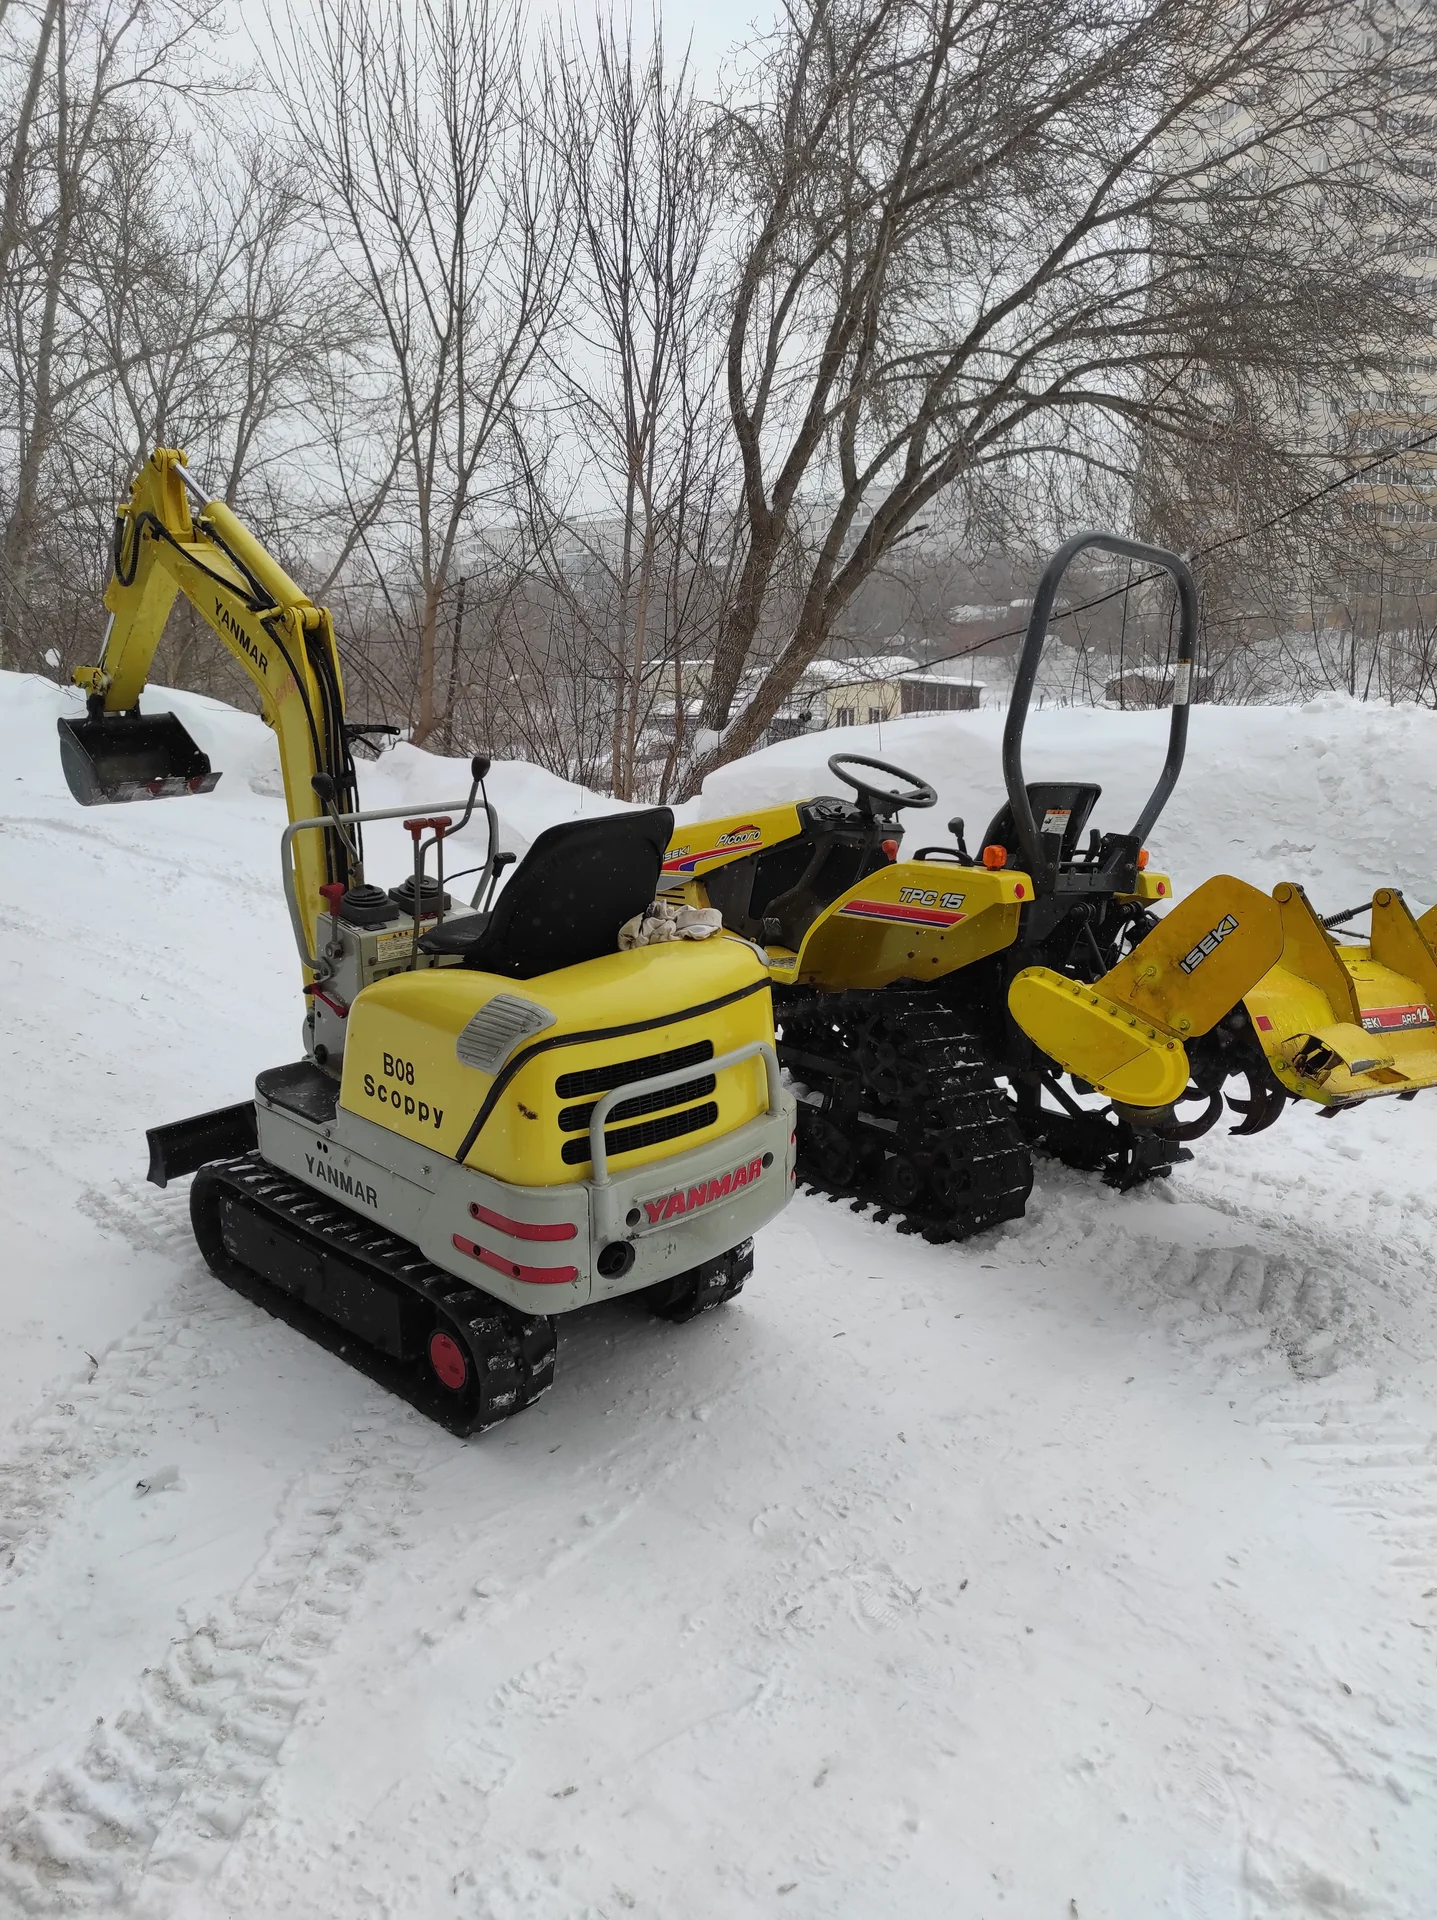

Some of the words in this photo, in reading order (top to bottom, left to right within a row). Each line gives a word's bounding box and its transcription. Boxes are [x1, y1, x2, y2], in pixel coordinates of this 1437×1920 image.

[214, 597, 268, 675] YANMAR
[900, 887, 937, 905] TPC
[940, 893, 966, 909] 15
[1179, 914, 1239, 974] ISEKI
[1361, 1017, 1381, 1029] SEKI
[383, 1052, 414, 1086] B08
[363, 1073, 444, 1129] Scoppy
[305, 1152, 379, 1209] YANMAR
[643, 1156, 763, 1224] YANMAR
